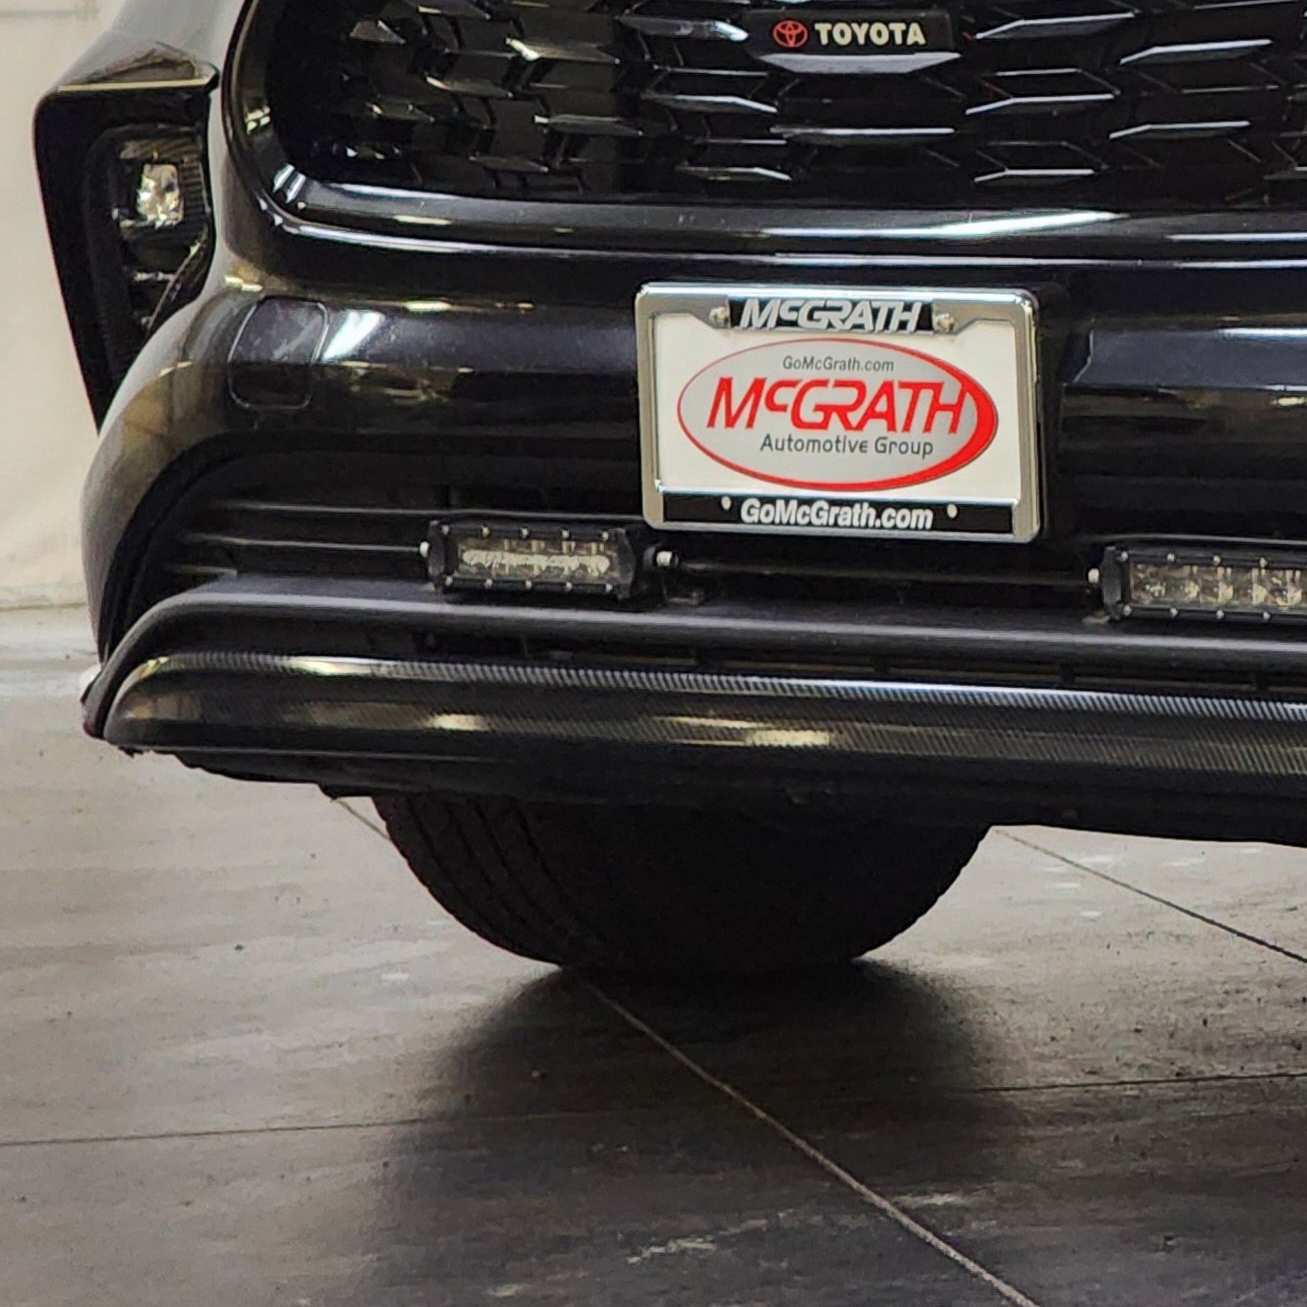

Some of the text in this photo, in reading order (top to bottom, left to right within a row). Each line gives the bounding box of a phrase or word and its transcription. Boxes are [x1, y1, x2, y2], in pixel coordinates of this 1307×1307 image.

[814, 22, 926, 46] TOYOTA
[782, 355, 895, 373] GoMcGrath.com
[759, 433, 934, 460] Automotive Group
[740, 497, 934, 530] GoMcGrath.com
